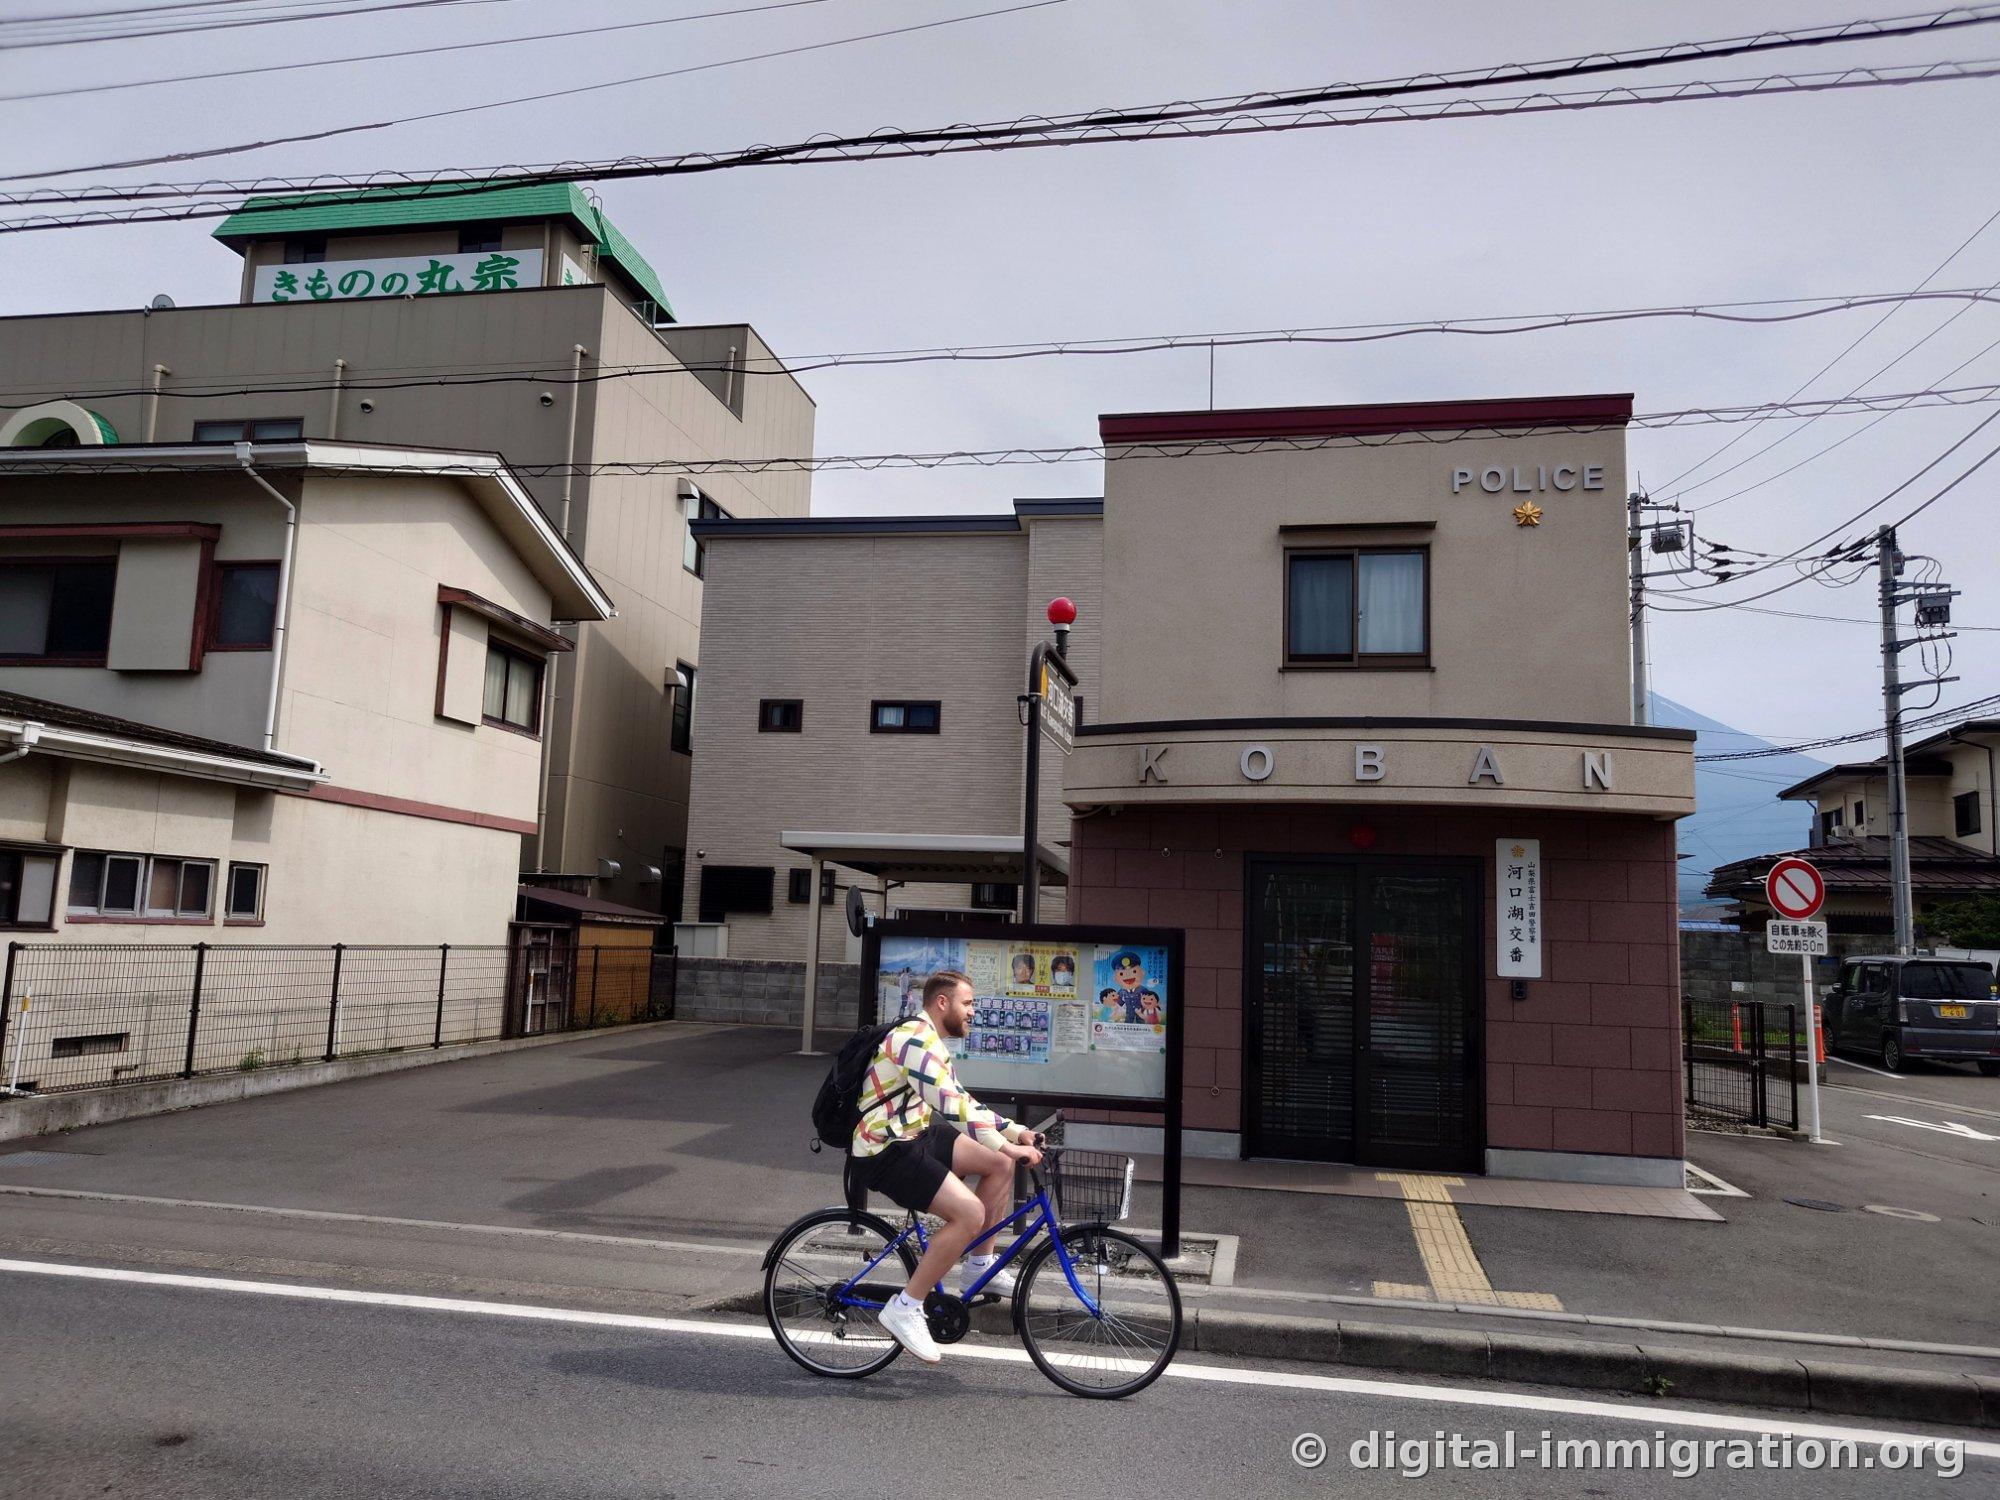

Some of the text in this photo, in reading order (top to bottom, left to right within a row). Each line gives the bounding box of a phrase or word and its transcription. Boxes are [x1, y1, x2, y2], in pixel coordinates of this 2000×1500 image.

[271, 253, 520, 302] きものの丸宗
[1453, 463, 1604, 493] POLICE
[1138, 744, 1613, 790] KOBAN
[1507, 864, 1524, 964] 河口湖交番
[1771, 924, 1823, 938] 自転車を除く
[1771, 939, 1825, 952] この先約50m
[980, 997, 1048, 1012] 重要指名手配
